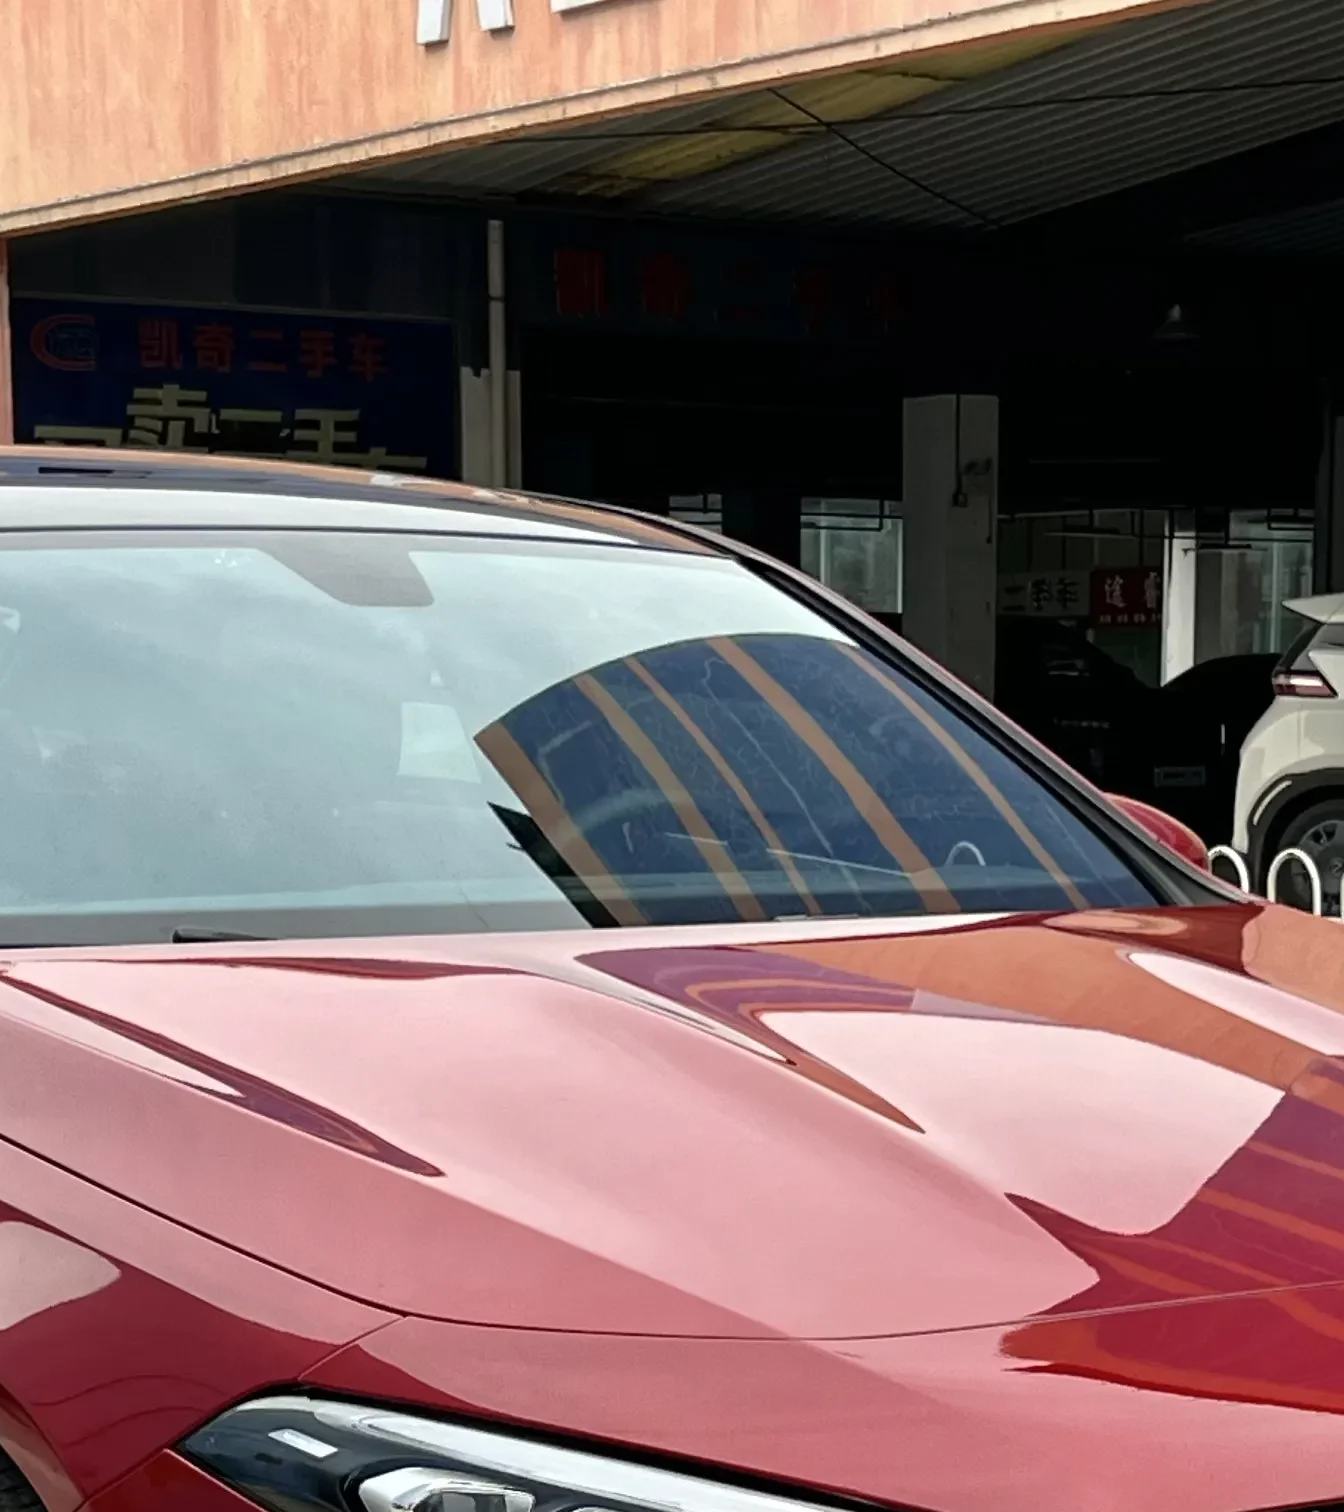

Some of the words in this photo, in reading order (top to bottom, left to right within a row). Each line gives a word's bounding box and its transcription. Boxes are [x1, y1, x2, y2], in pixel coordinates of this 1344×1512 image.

[135, 316, 389, 383] 凯奇二手车
